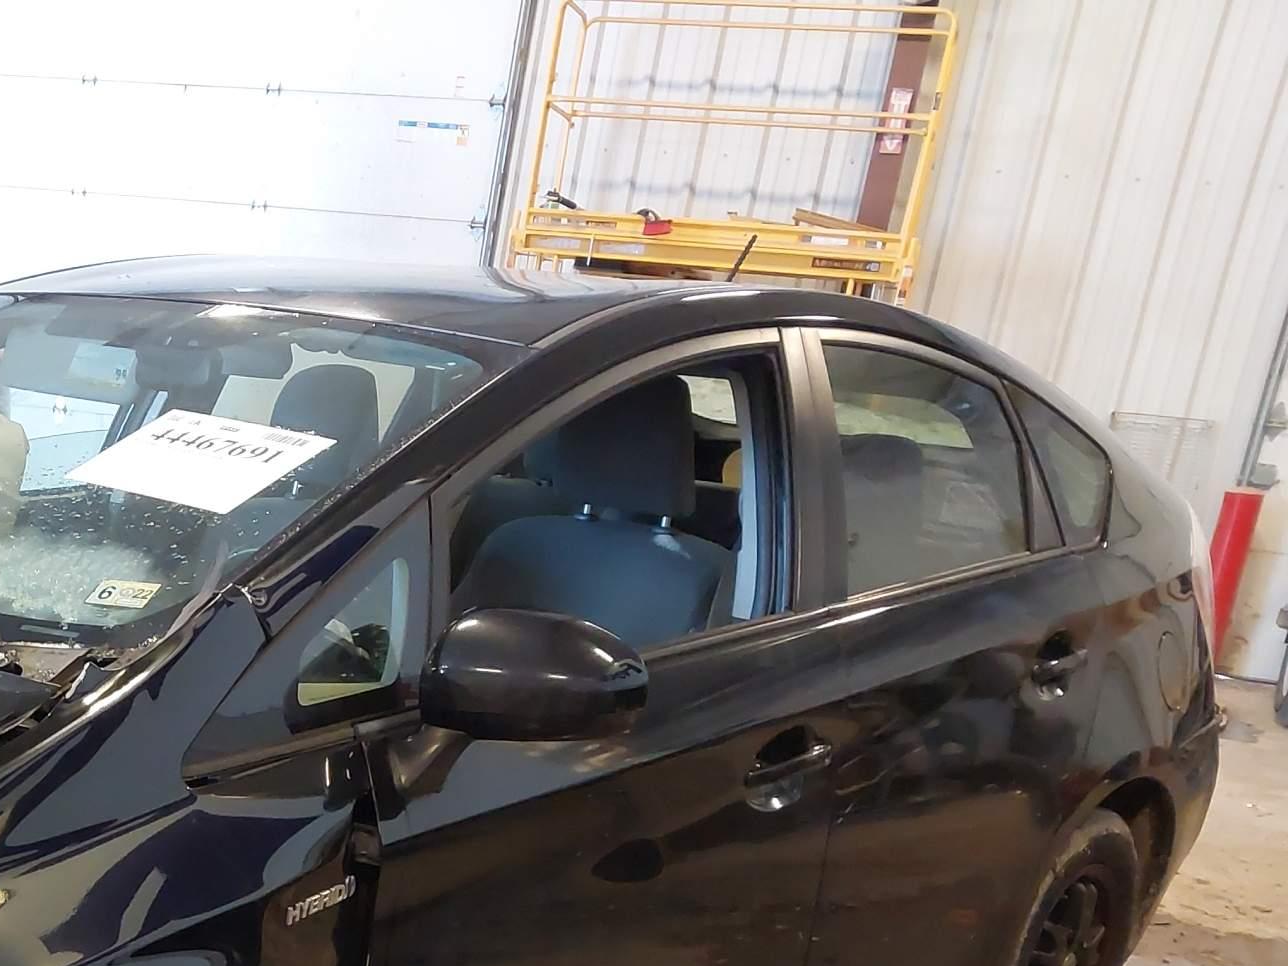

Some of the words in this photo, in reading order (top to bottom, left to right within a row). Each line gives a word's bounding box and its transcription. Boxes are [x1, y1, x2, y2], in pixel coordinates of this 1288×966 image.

[151, 428, 285, 464] 44467691
[98, 585, 117, 600] 6
[131, 588, 154, 600] 22
